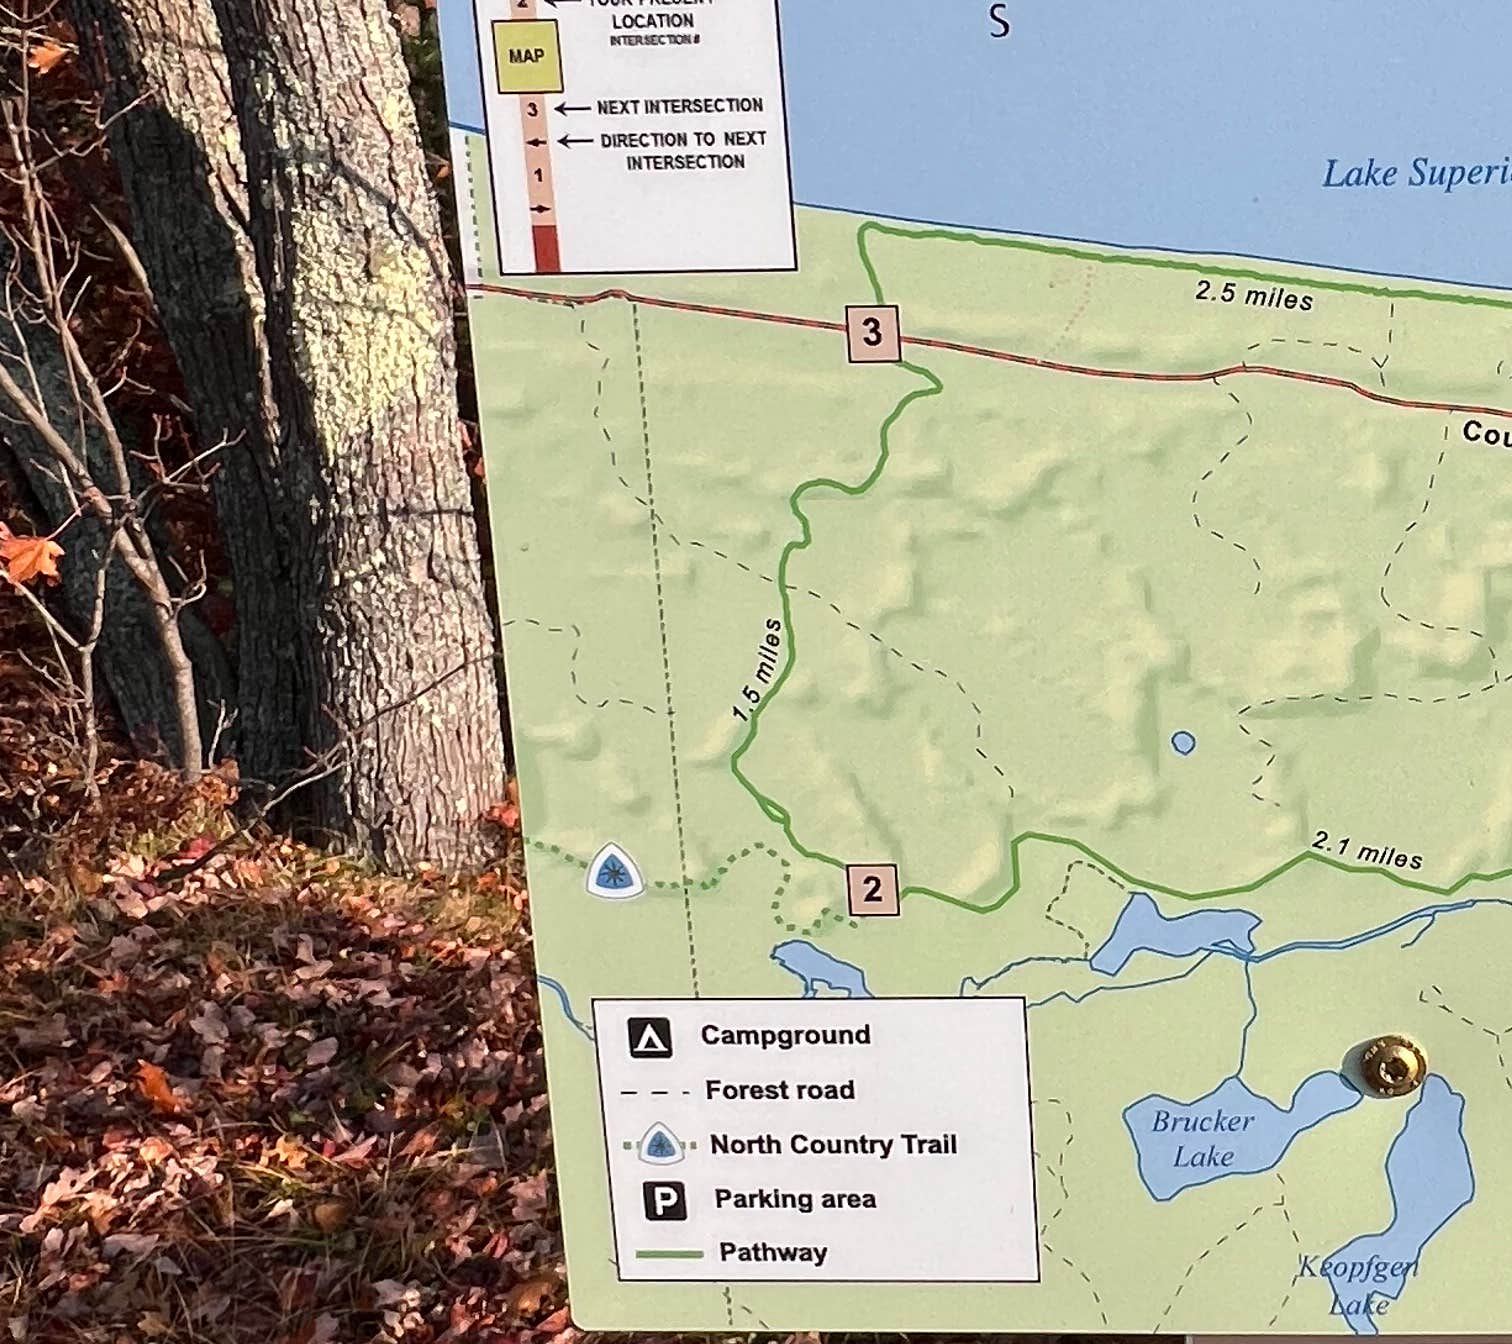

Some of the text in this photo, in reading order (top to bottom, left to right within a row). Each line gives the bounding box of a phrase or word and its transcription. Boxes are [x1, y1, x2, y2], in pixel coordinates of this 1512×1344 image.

[612, 14, 694, 29] LOCATION
[990, 3, 1010, 38] S
[509, 48, 544, 63] MAP
[528, 102, 538, 116] 3
[597, 97, 763, 115] NEXT INTERSECTION
[601, 131, 767, 147] DIRECTION TO NEXT
[627, 155, 745, 170] INTERSECTION
[1322, 158, 1398, 187] Lake
[534, 168, 544, 182] 1
[1195, 280, 1313, 311] 2.5 miles
[862, 317, 882, 346] 3
[733, 619, 781, 721] 1.5 miles
[1312, 831, 1423, 870] 2.1 miles
[863, 876, 883, 902] 2
[701, 1024, 871, 1049] Campground
[706, 1080, 855, 1100] Forest road
[1152, 1110, 1255, 1133] Brucker
[710, 1134, 957, 1159] North Country Trail
[1174, 1145, 1234, 1167] Lake
[715, 1188, 877, 1213] Parking area
[720, 1242, 828, 1266] Pathway
[1297, 1255, 1418, 1282] Keopfgen
[1329, 1294, 1390, 1316] Lake
